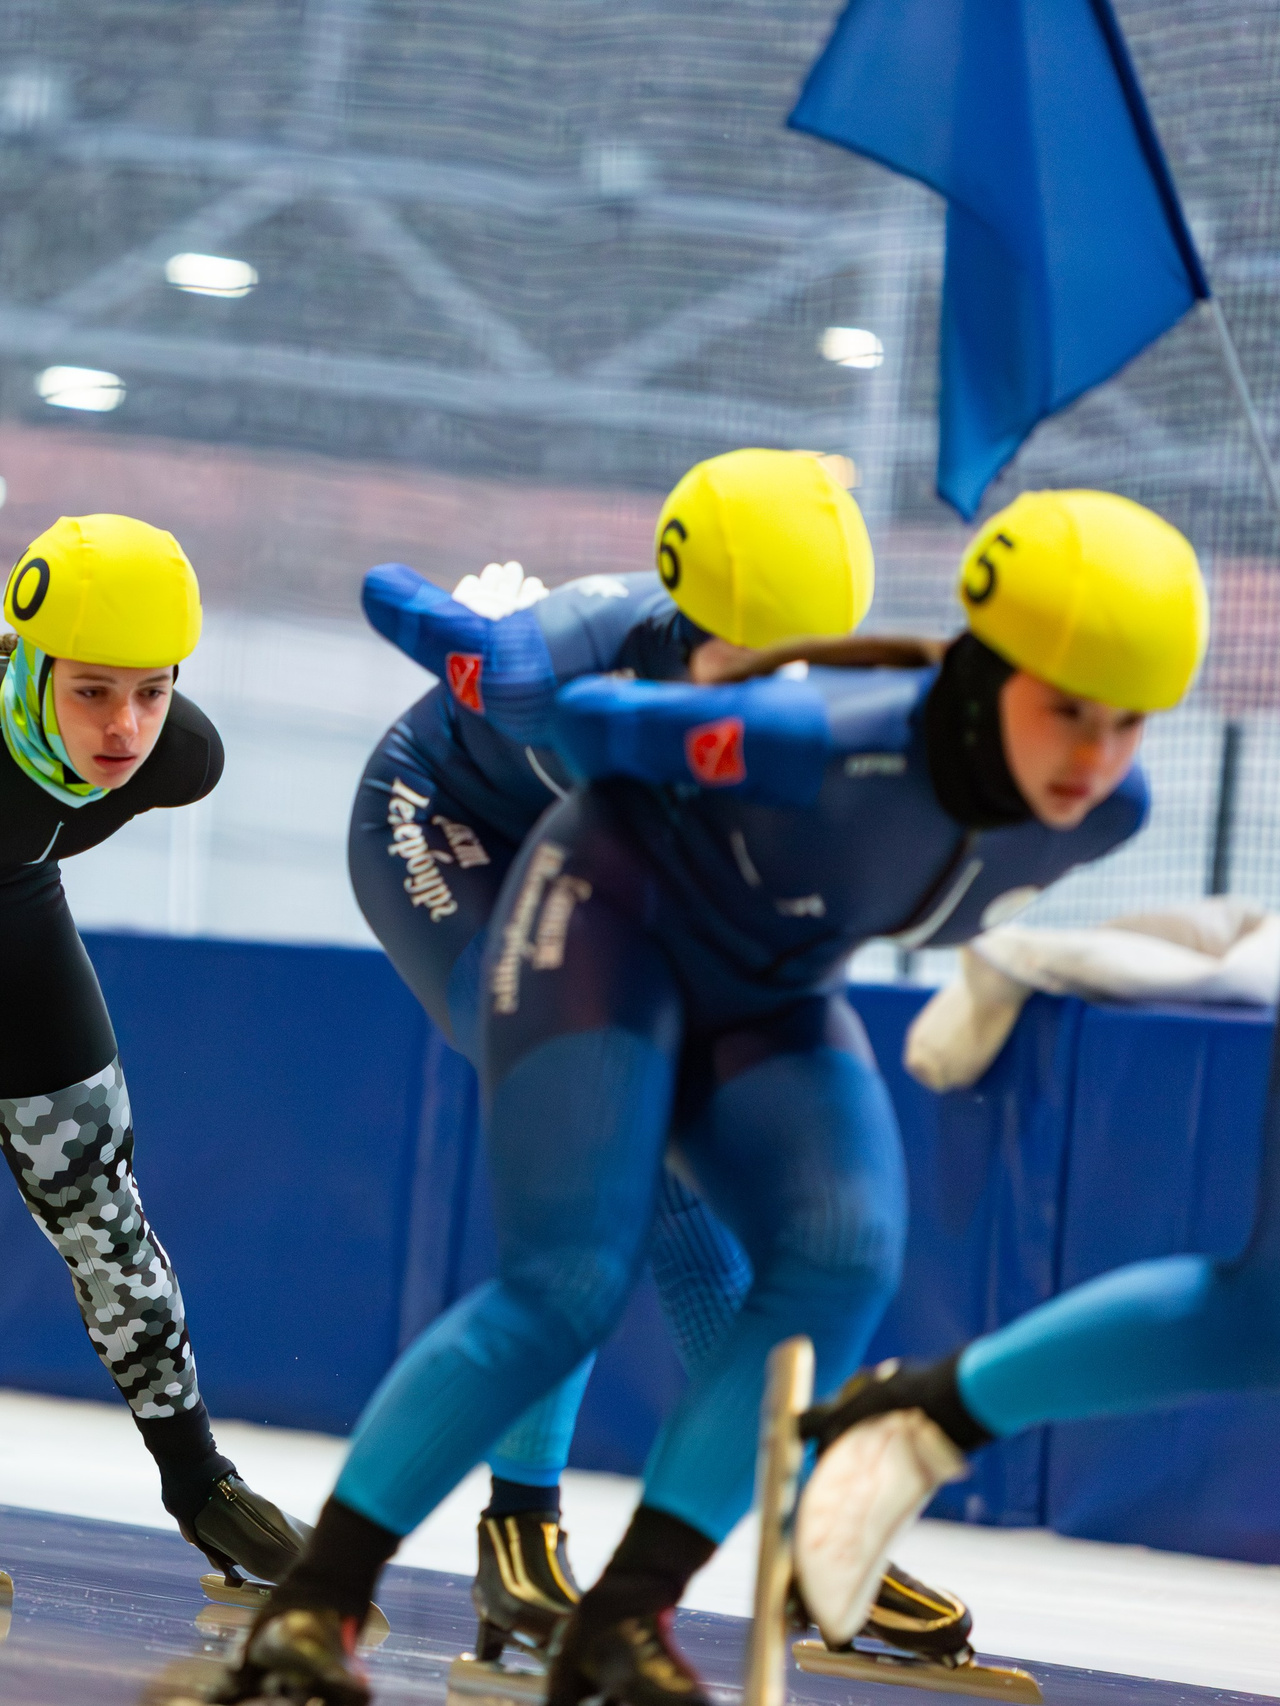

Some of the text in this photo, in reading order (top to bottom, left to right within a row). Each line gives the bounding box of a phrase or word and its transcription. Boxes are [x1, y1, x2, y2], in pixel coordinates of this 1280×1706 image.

[3, 547, 50, 622] 0
[660, 518, 688, 590] 6
[966, 533, 1014, 606] 5
